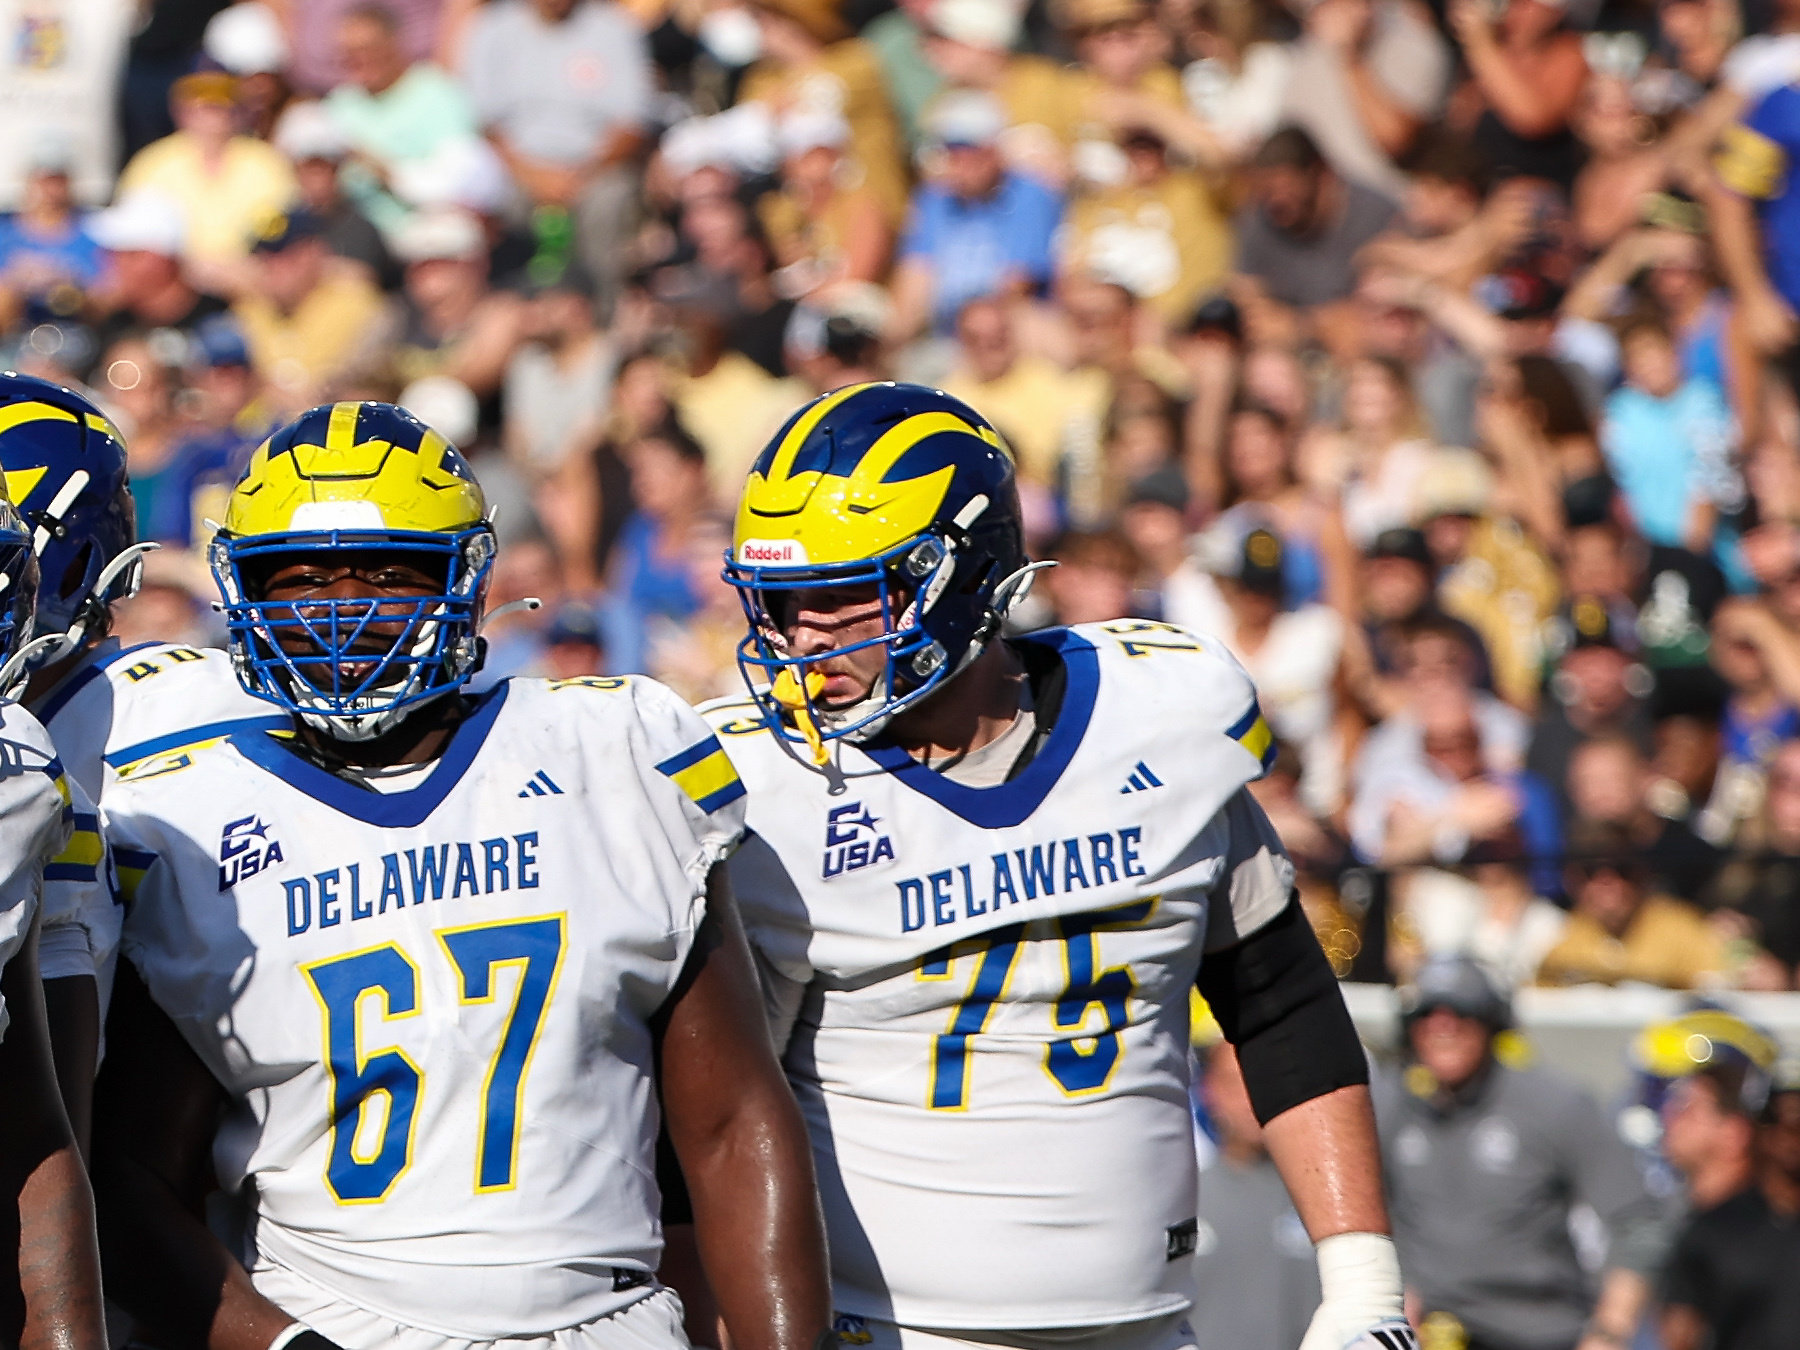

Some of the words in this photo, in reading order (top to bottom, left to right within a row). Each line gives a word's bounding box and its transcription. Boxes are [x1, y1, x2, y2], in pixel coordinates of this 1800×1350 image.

[744, 545, 793, 561] Riddell
[218, 840, 284, 892] USA
[280, 831, 540, 938] DELAWARE
[822, 836, 895, 879] USA
[894, 826, 1147, 934] DELAWARE
[914, 894, 1162, 1112] 75
[296, 910, 569, 1206] 67
